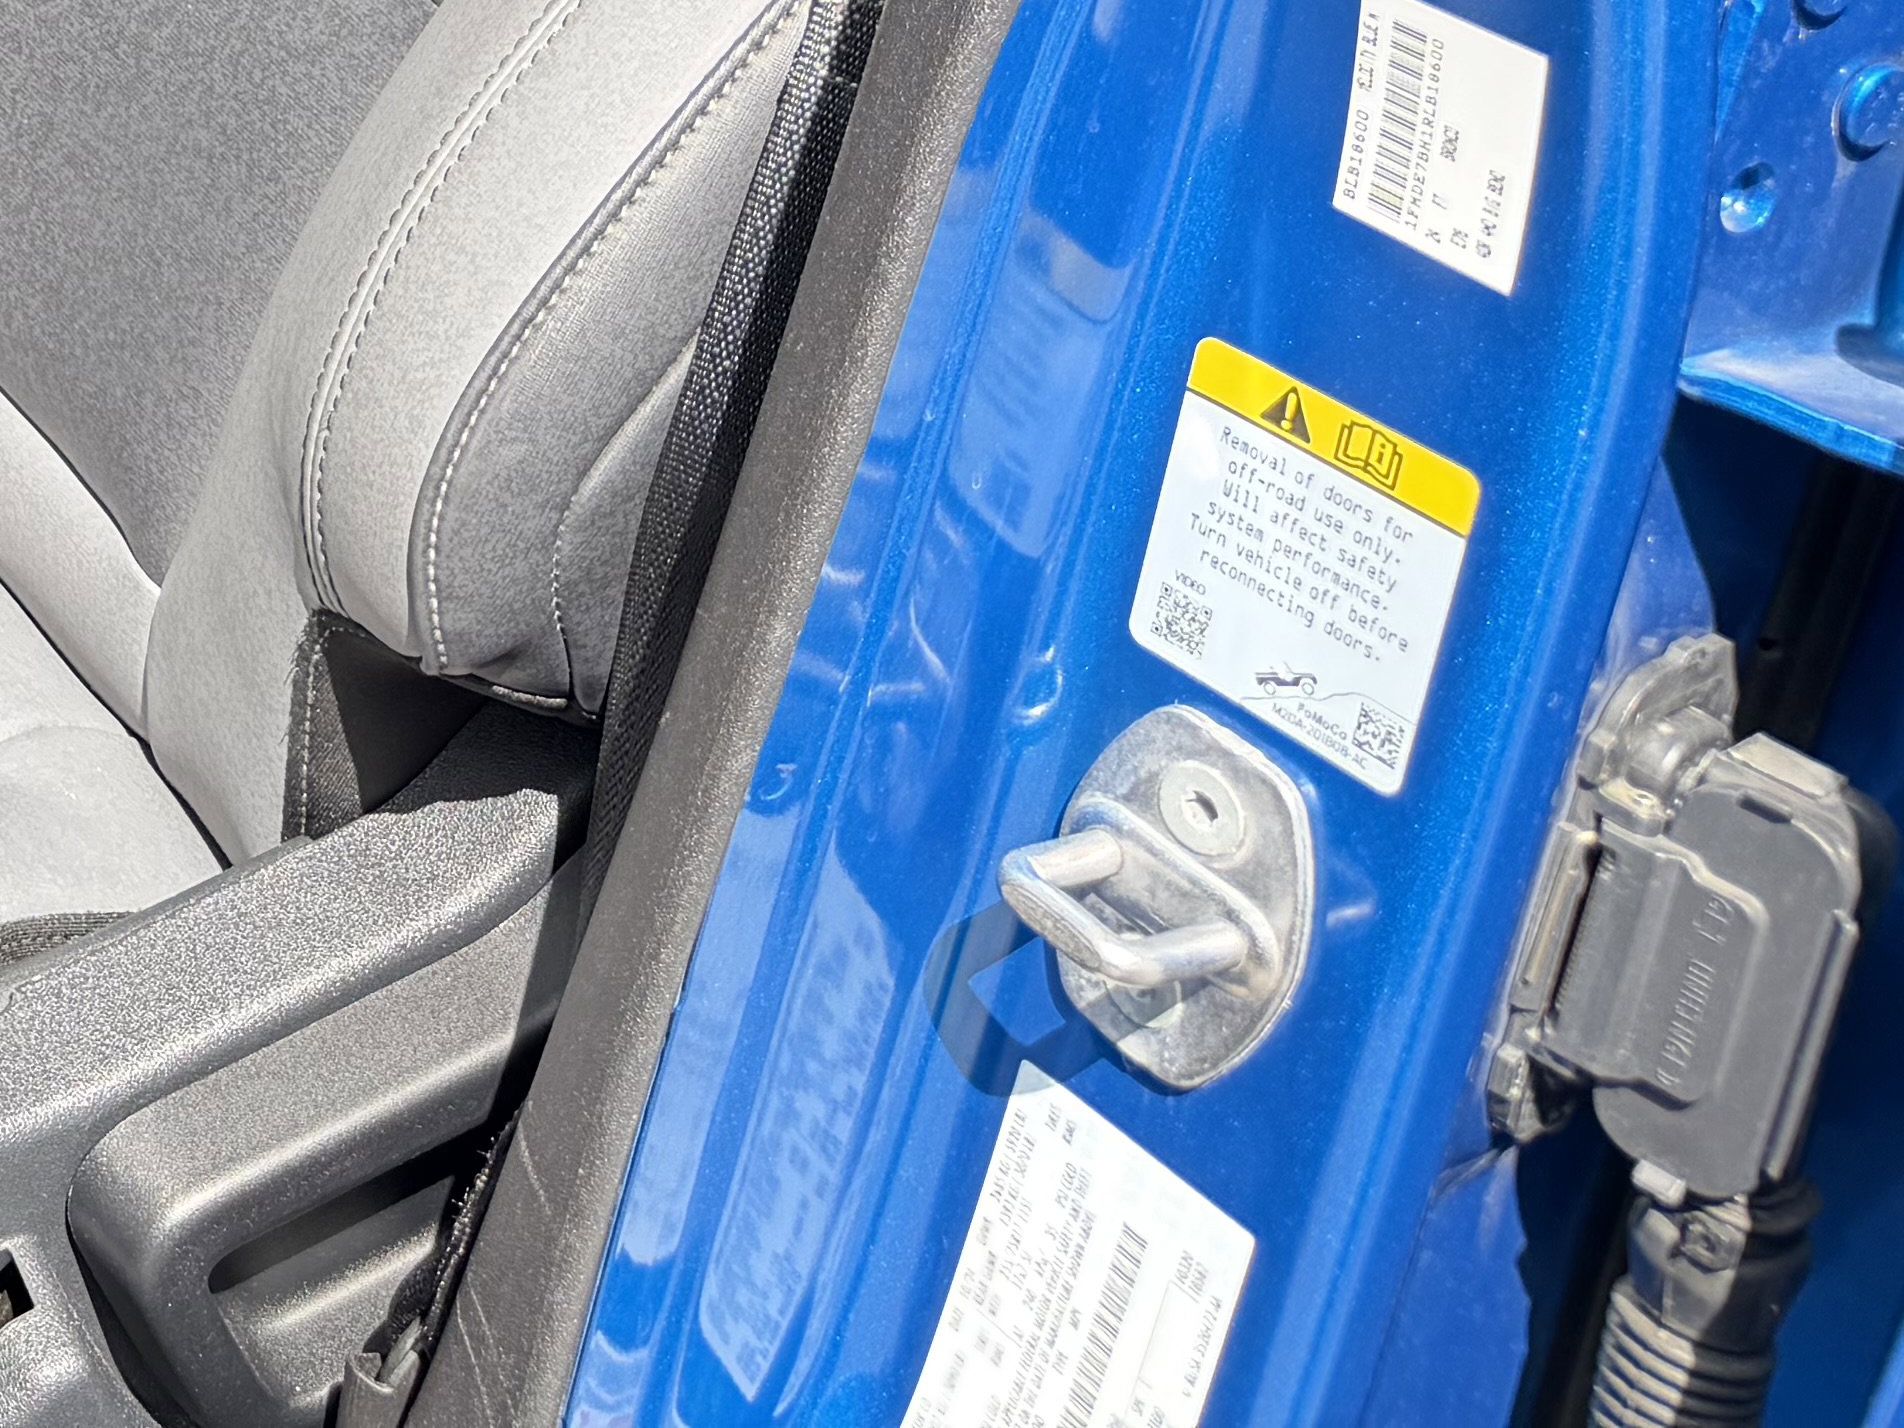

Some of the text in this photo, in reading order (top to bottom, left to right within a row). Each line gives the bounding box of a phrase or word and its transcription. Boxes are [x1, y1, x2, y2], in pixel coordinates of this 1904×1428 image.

[1342, 108, 1369, 200] BLB18600
[1219, 425, 1413, 542] Removal of doors for
[1222, 478, 1397, 594] Will affect safety
[1227, 460, 1401, 565] off-road use only.
[1174, 569, 1206, 596] VIDEO
[1190, 511, 1409, 653] Turn vehicle off before
[1198, 549, 1380, 662] reconnecting doors.
[1206, 500, 1388, 611] system performance.
